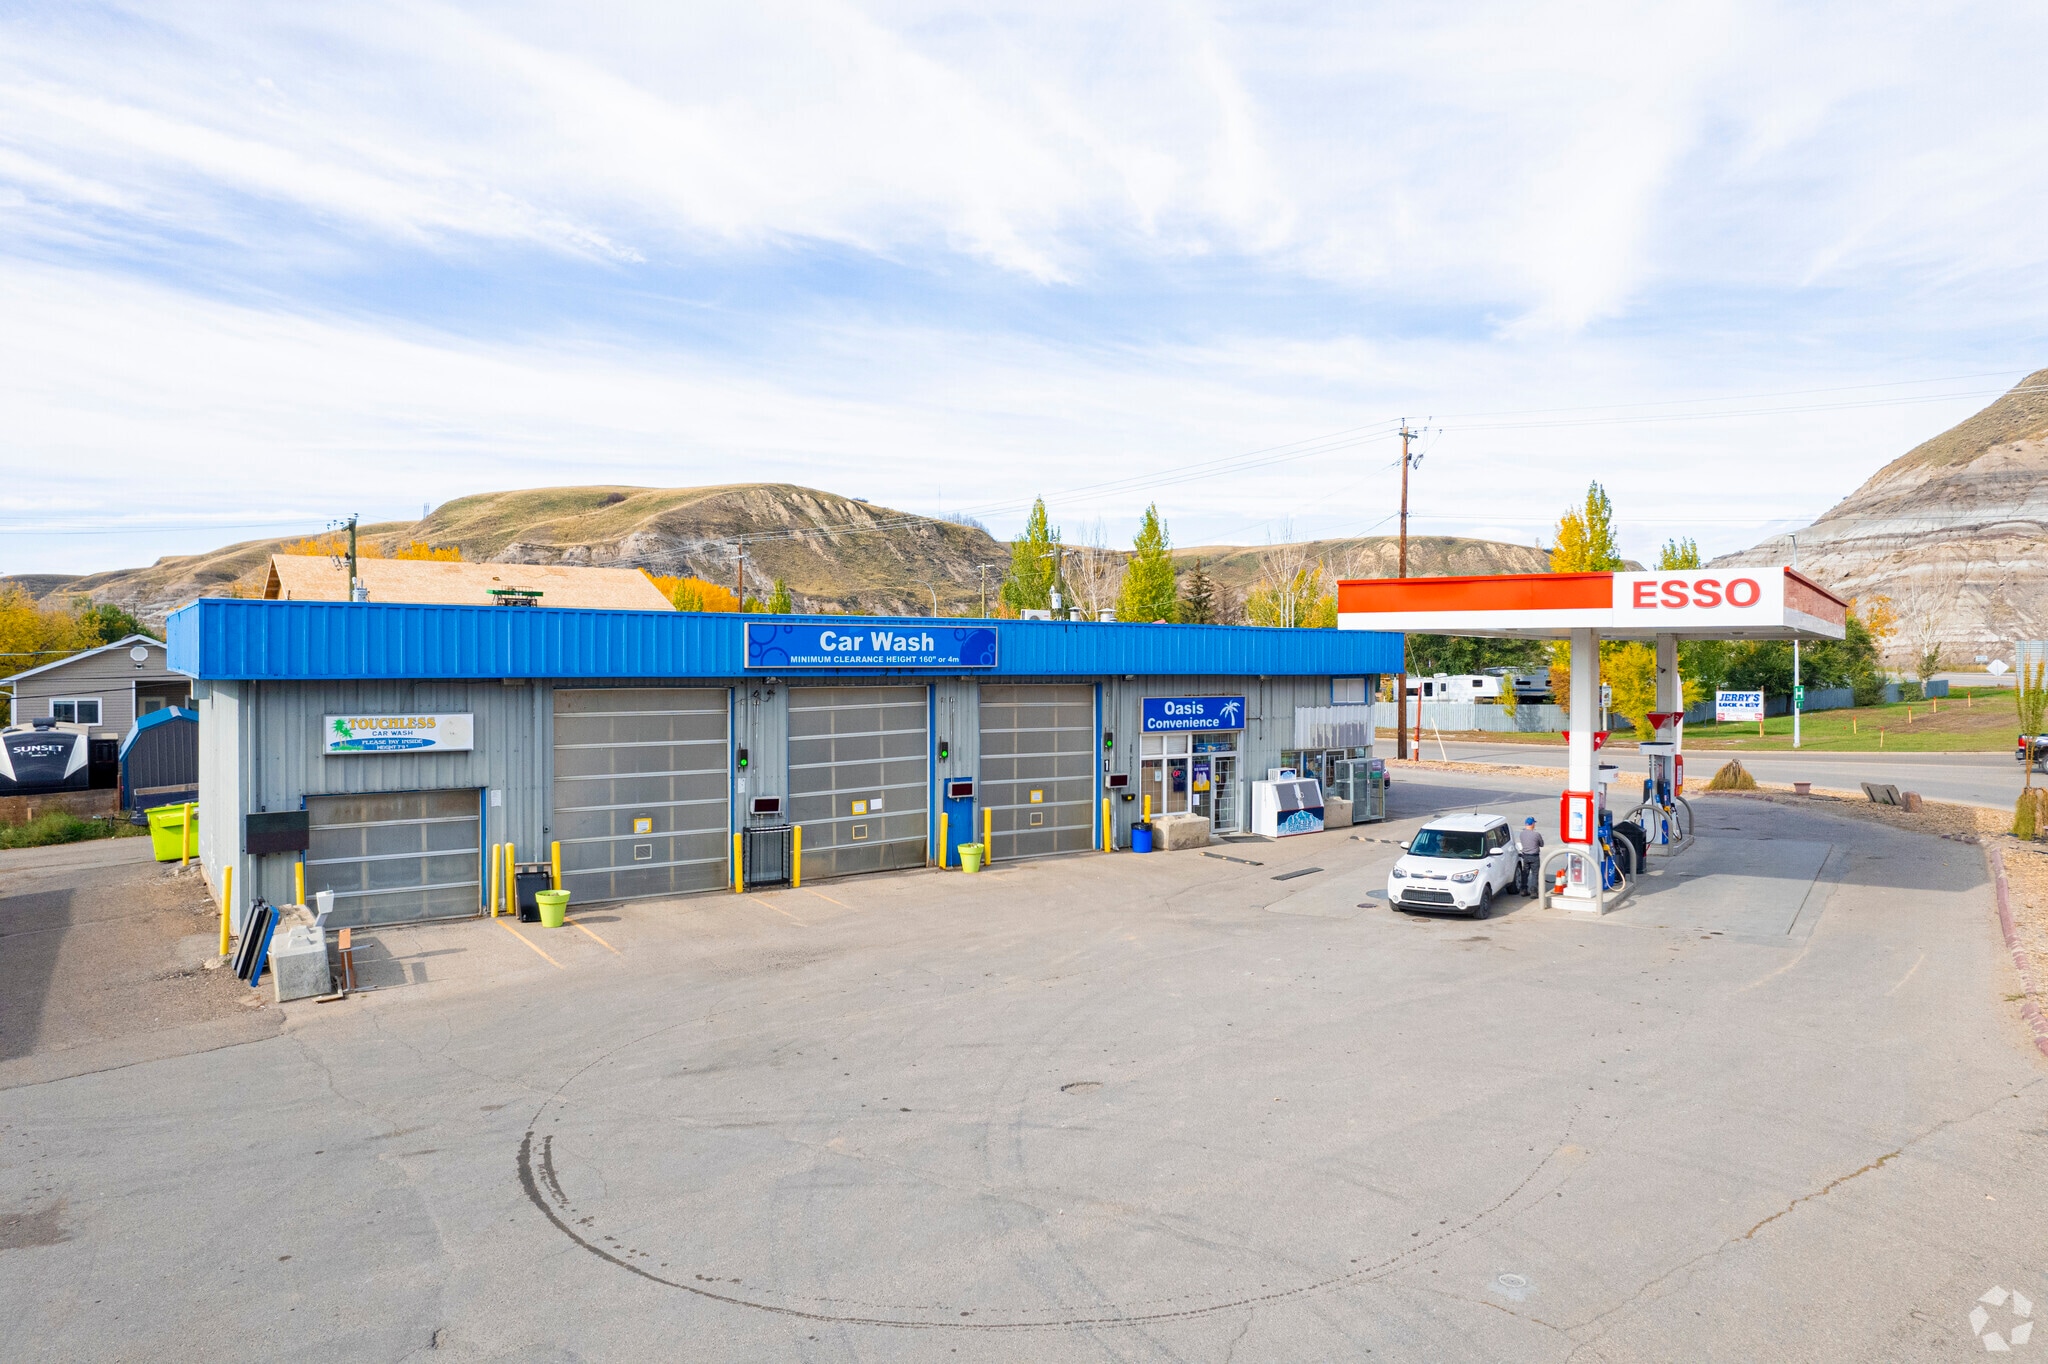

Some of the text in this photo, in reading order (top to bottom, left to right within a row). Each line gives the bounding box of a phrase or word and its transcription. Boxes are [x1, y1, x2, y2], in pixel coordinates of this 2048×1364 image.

[1633, 578, 1761, 608] ESSO
[820, 631, 934, 652] Car Wash
[790, 655, 831, 663] MINIMUM
[833, 655, 884, 663] CLEARANCE
[886, 655, 916, 663] HEIGHT
[919, 655, 937, 663] 160"
[947, 655, 960, 663] 4m
[1720, 694, 1760, 702] JERRY'S
[1796, 688, 1804, 700] H
[1164, 701, 1204, 715] Oasis
[348, 717, 436, 730] TOUCHLESS
[1147, 717, 1220, 729] Convenience
[13, 745, 64, 753] SUNSET
